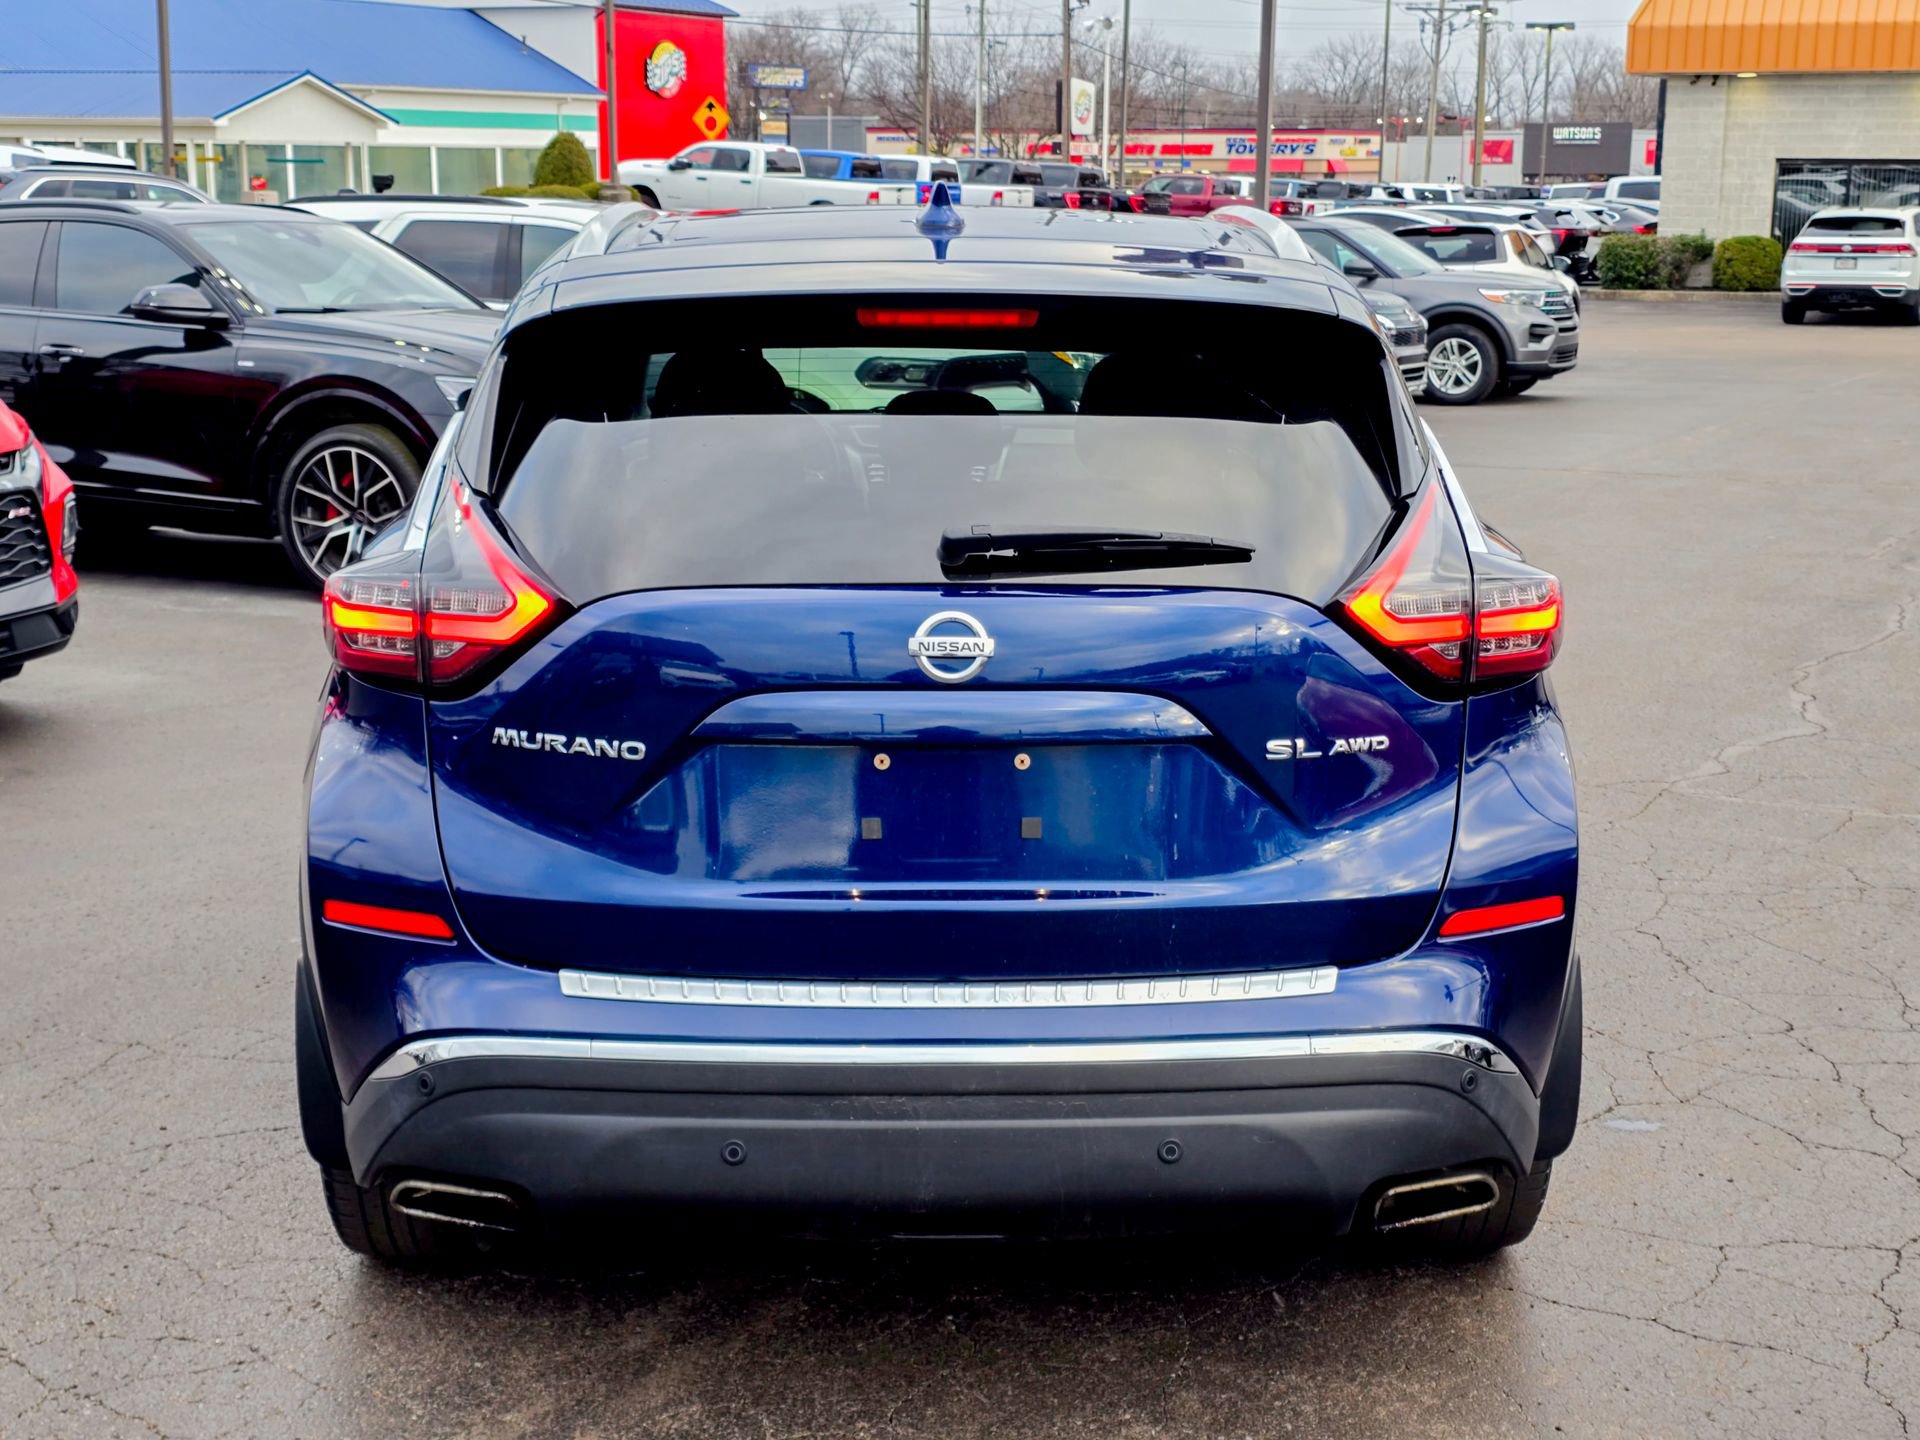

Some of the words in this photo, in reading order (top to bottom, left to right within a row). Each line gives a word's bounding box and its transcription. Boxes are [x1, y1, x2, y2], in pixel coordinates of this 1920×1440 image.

[918, 641, 985, 653] NISSAN
[491, 726, 647, 761] MURANO
[1265, 737, 1323, 760] SL
[1328, 735, 1390, 756] AWD
